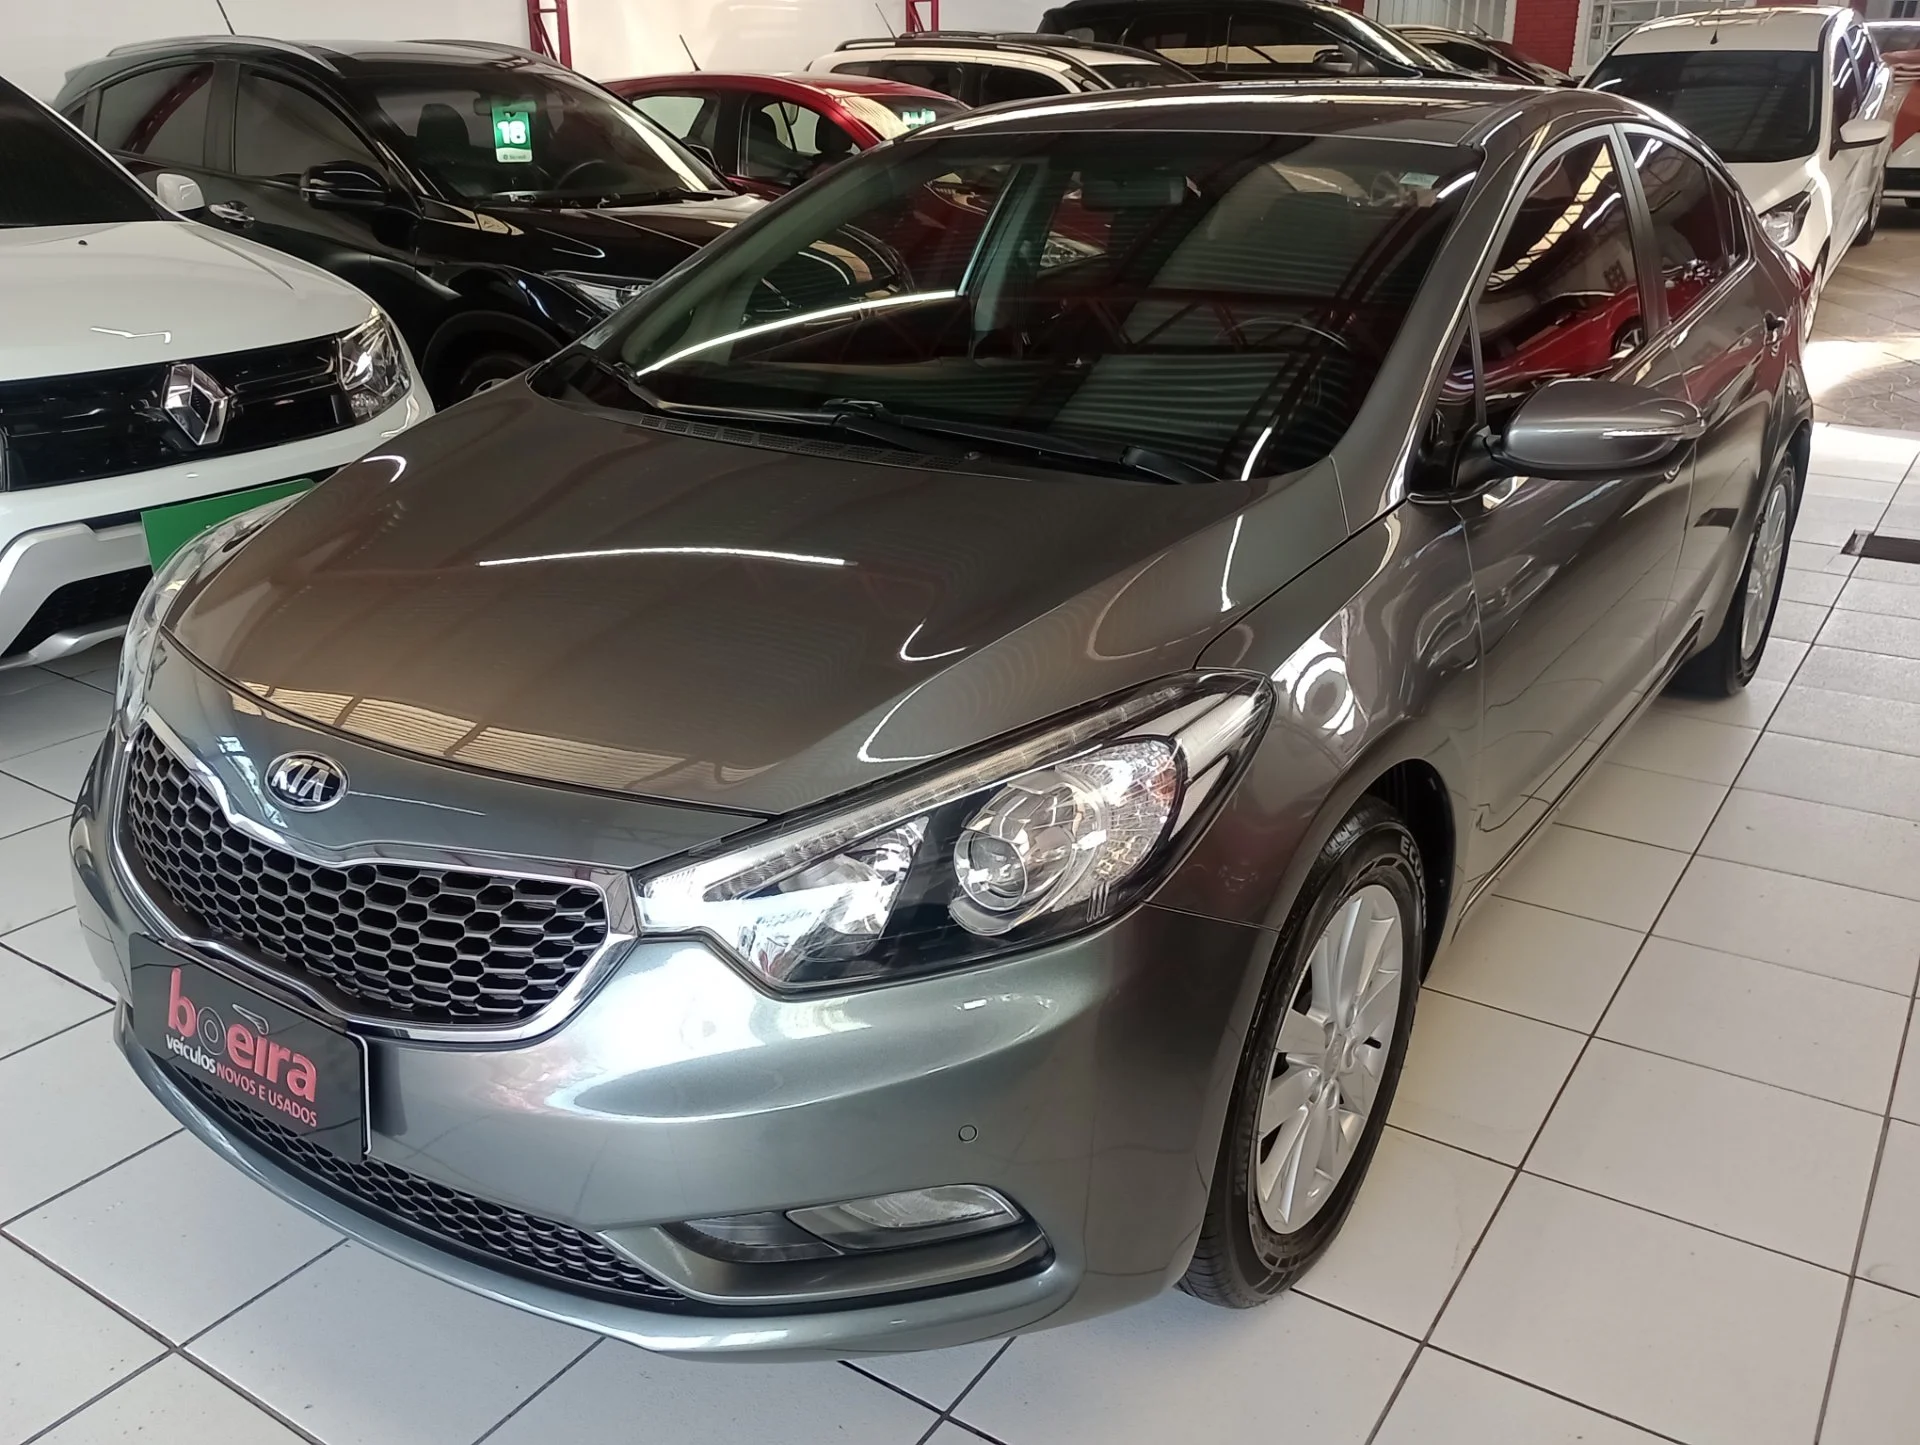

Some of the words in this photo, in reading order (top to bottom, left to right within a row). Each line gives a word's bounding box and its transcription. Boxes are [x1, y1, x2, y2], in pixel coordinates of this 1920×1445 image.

[270, 757, 332, 803] KIA
[168, 968, 317, 1102] boeira
[216, 1061, 256, 1095] NOVOS
[258, 1084, 267, 1102] E
[268, 1088, 318, 1128] USADOS
